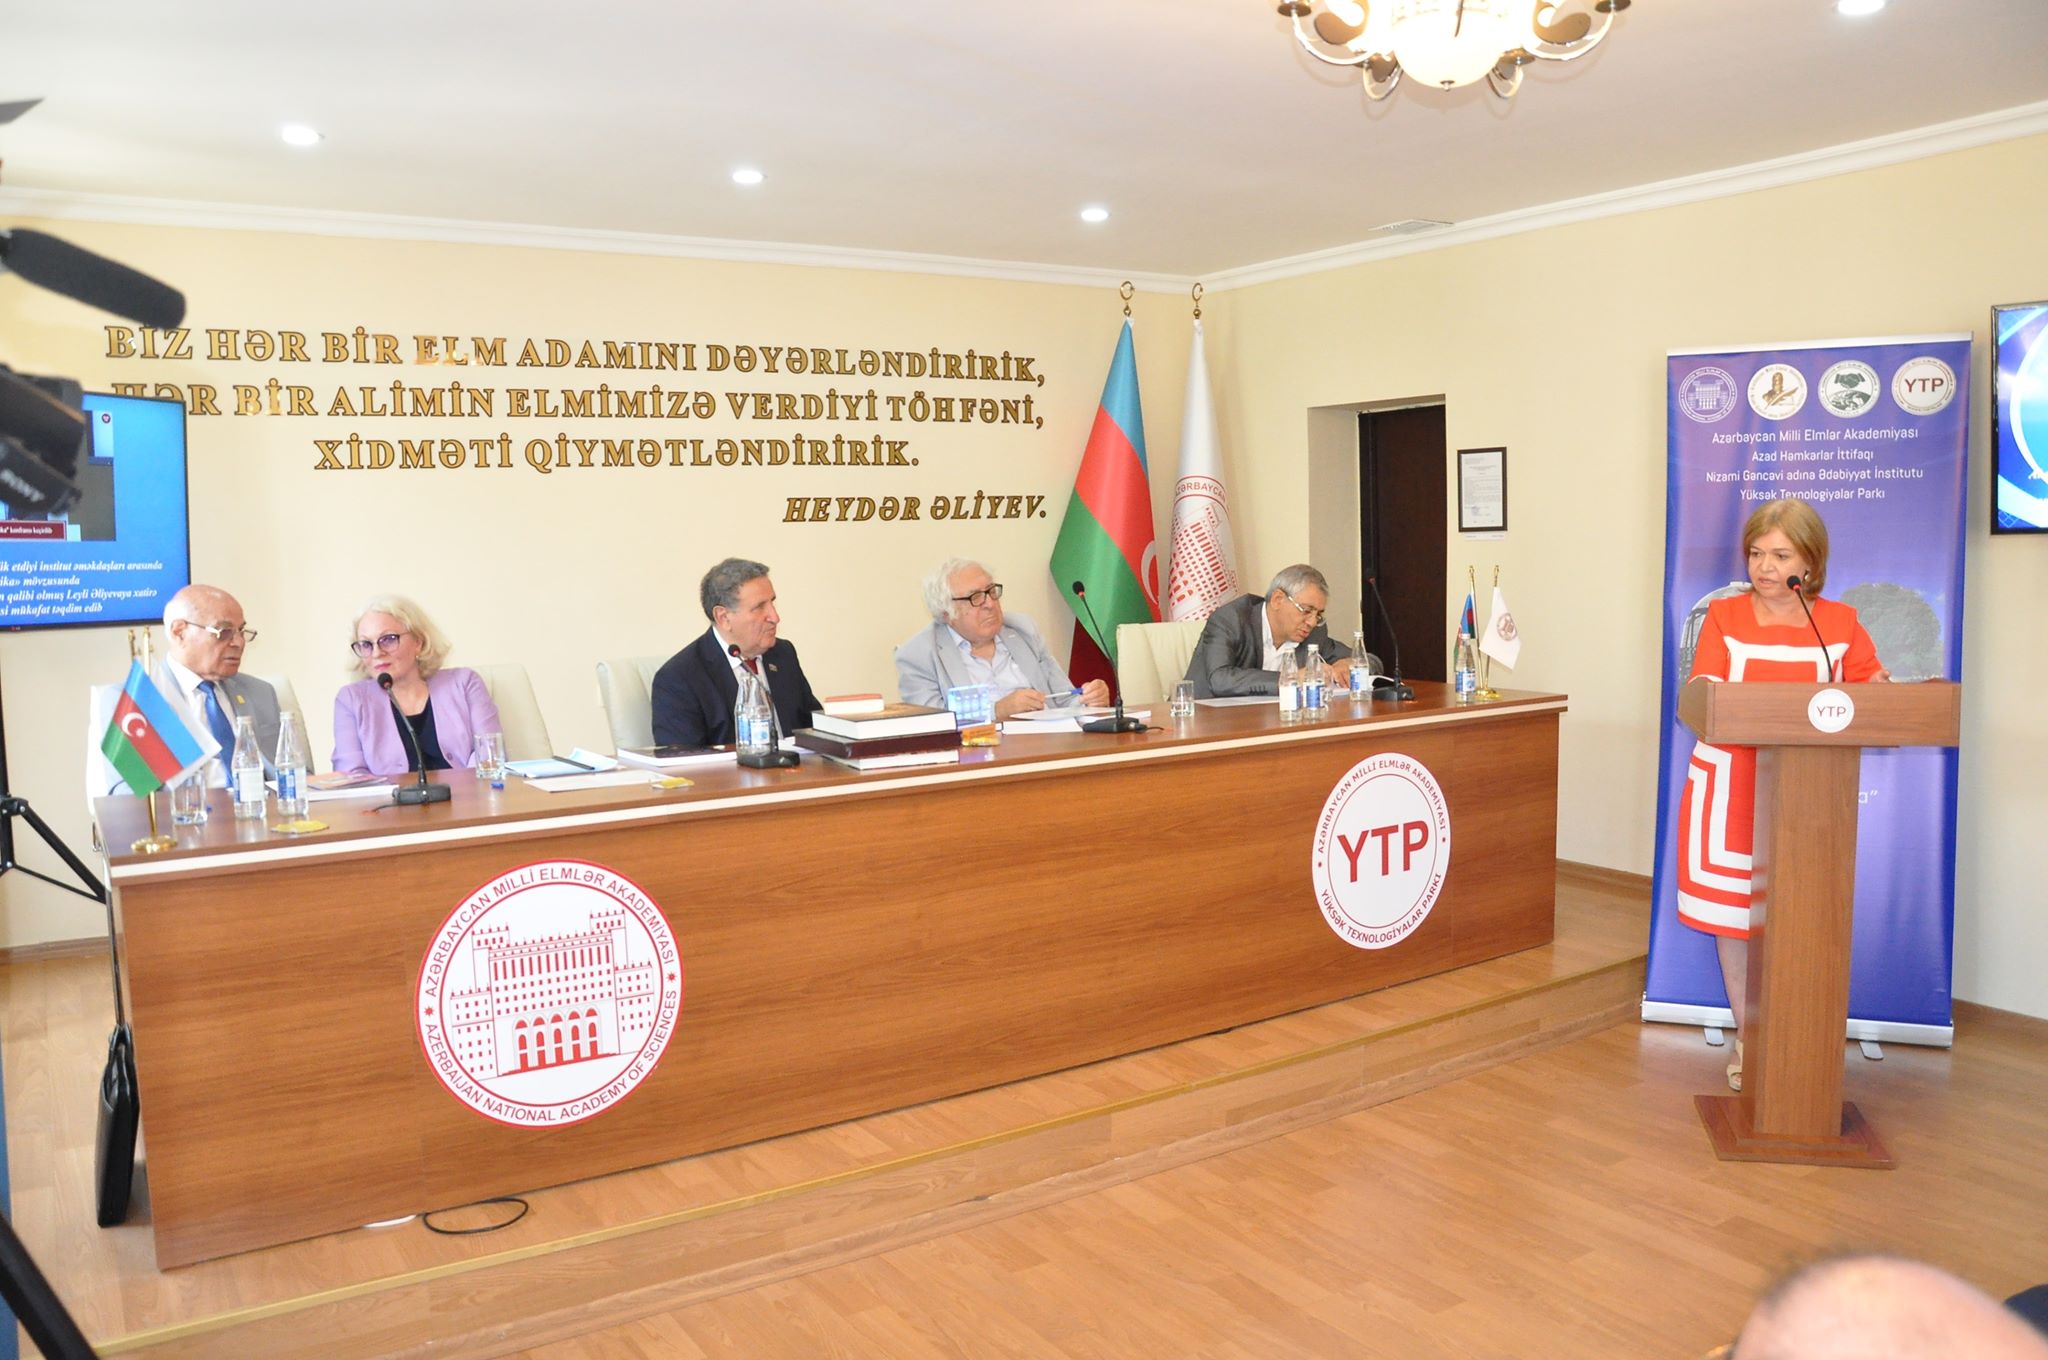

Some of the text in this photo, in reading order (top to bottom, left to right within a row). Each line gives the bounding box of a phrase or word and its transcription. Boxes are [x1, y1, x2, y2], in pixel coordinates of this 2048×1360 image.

[205, 328, 311, 362] HƏR
[322, 326, 403, 364] BİR
[413, 335, 508, 367] ELM
[516, 338, 697, 371] ADAMINI
[706, 344, 1045, 388] DƏYƏRLƏNDİRİRİK,
[233, 378, 318, 417] BİR
[328, 380, 494, 418] ALİMİN
[506, 384, 717, 419] ELMİMİZƏ
[725, 388, 878, 422] VERDİYİ
[886, 391, 1044, 430] TÖHFƏNİ,
[1905, 378, 1944, 393] YTP
[314, 432, 920, 474] XİDMƏTİ QİYMƏTLƏNDİRİRİK.
[1712, 427, 1918, 444] Azərbaycan Milli Elmlər Akademiyası
[1752, 447, 1874, 462] Azad Həmkarlar İttifaqı
[1706, 465, 1923, 482] Nizami Gəncəvi adına Ədəbiyyat İnstitutu
[1740, 488, 1777, 501] Yüksək
[1857, 487, 1885, 499] Parkı
[783, 489, 1047, 523] HEYDƏR ƏLİYEV.
[1816, 705, 1847, 718] YTP
[1318, 760, 1446, 854] AZƏRBAYCAN MİLLİ ELMLƏR AKADEMİYASI
[1337, 820, 1429, 883] YTP
[1321, 873, 1441, 943] YÜKSƏK TEXNOLOGİYALAR PARKI
[425, 867, 675, 998] AZƏRBAYCAN MİLLİ ELMLƏR AKADEMİYASI
[425, 989, 677, 1122] AZERBAIJAN NATIONAL ACADEMY OF SCIENCES
